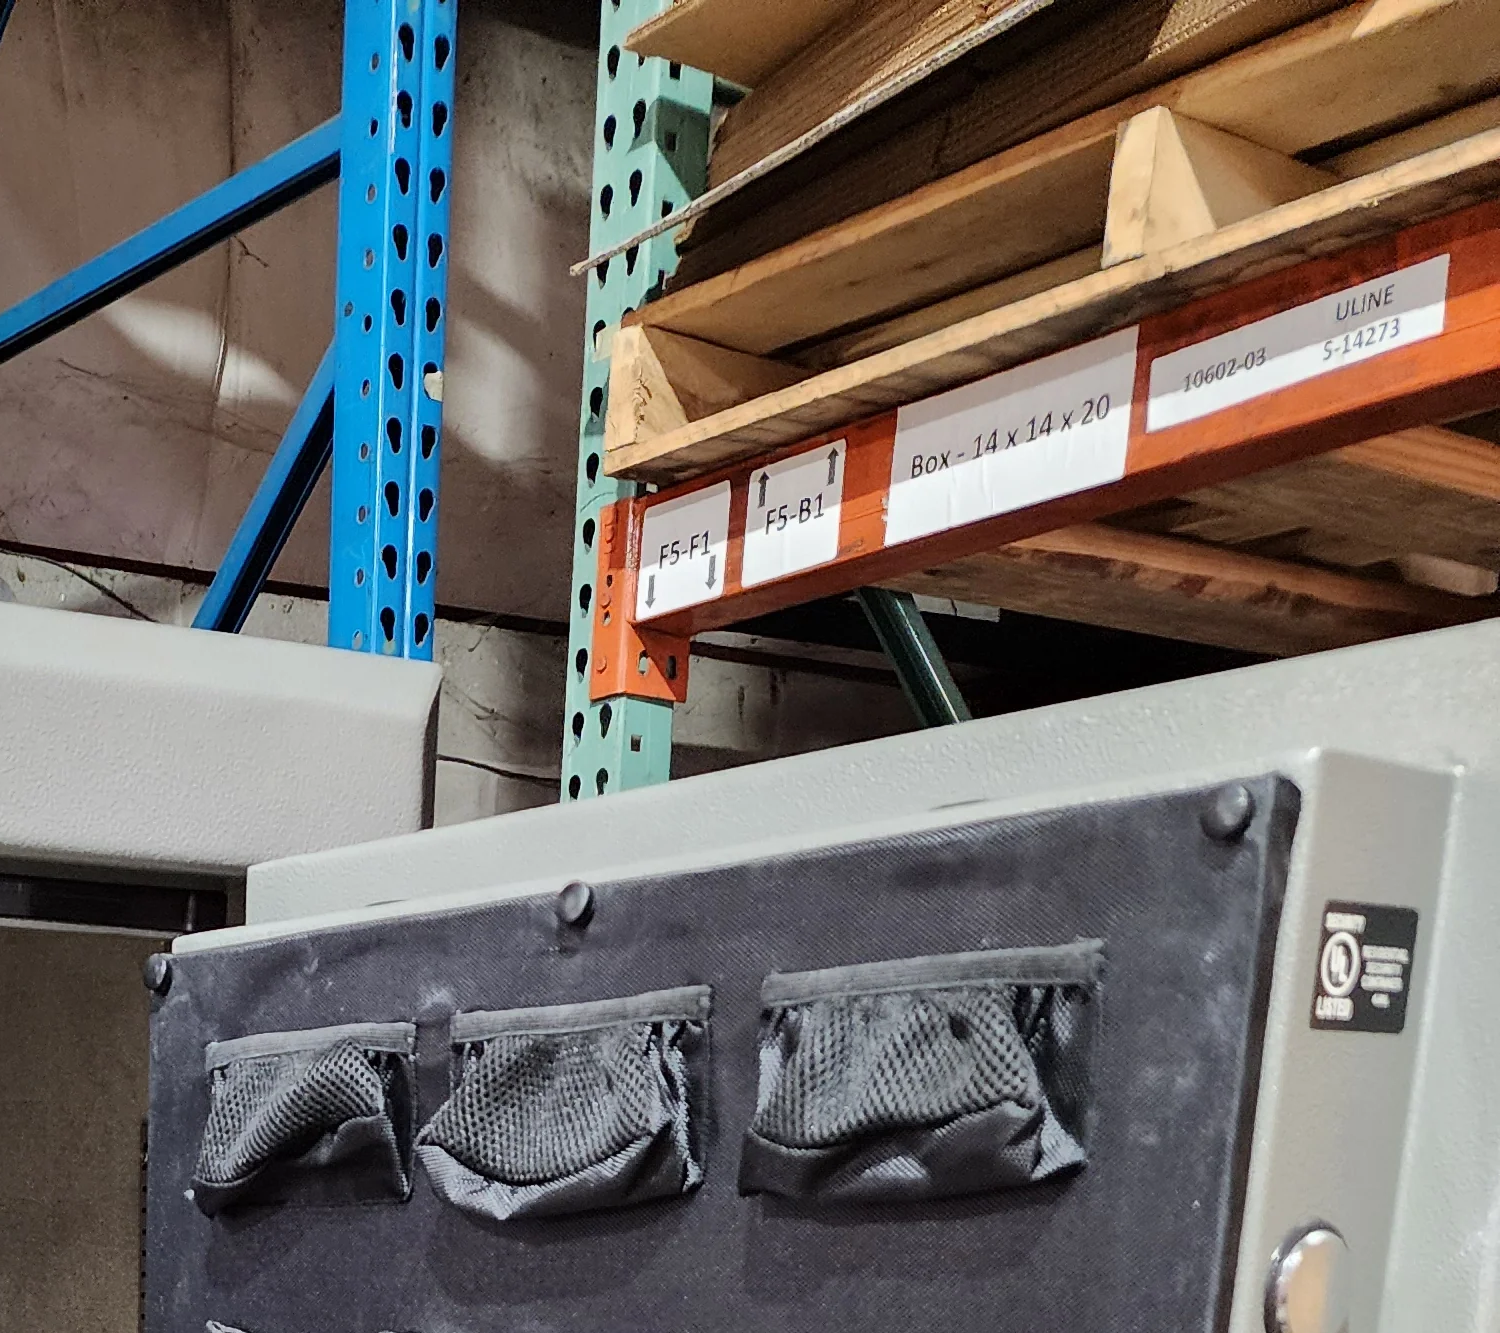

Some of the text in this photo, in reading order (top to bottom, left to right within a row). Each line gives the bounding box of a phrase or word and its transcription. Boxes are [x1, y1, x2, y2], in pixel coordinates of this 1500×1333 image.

[1336, 283, 1395, 322] ULINE
[1323, 317, 1400, 361] S-14273
[1183, 346, 1267, 393] 10602-03
[910, 450, 951, 479] Box
[972, 428, 998, 460] 14
[1005, 427, 1019, 450] x
[1026, 410, 1052, 443] 14
[1061, 409, 1075, 432] x
[1080, 393, 1111, 426] 20
[765, 492, 825, 536] F5-B1
[659, 529, 711, 569] F5-F1
